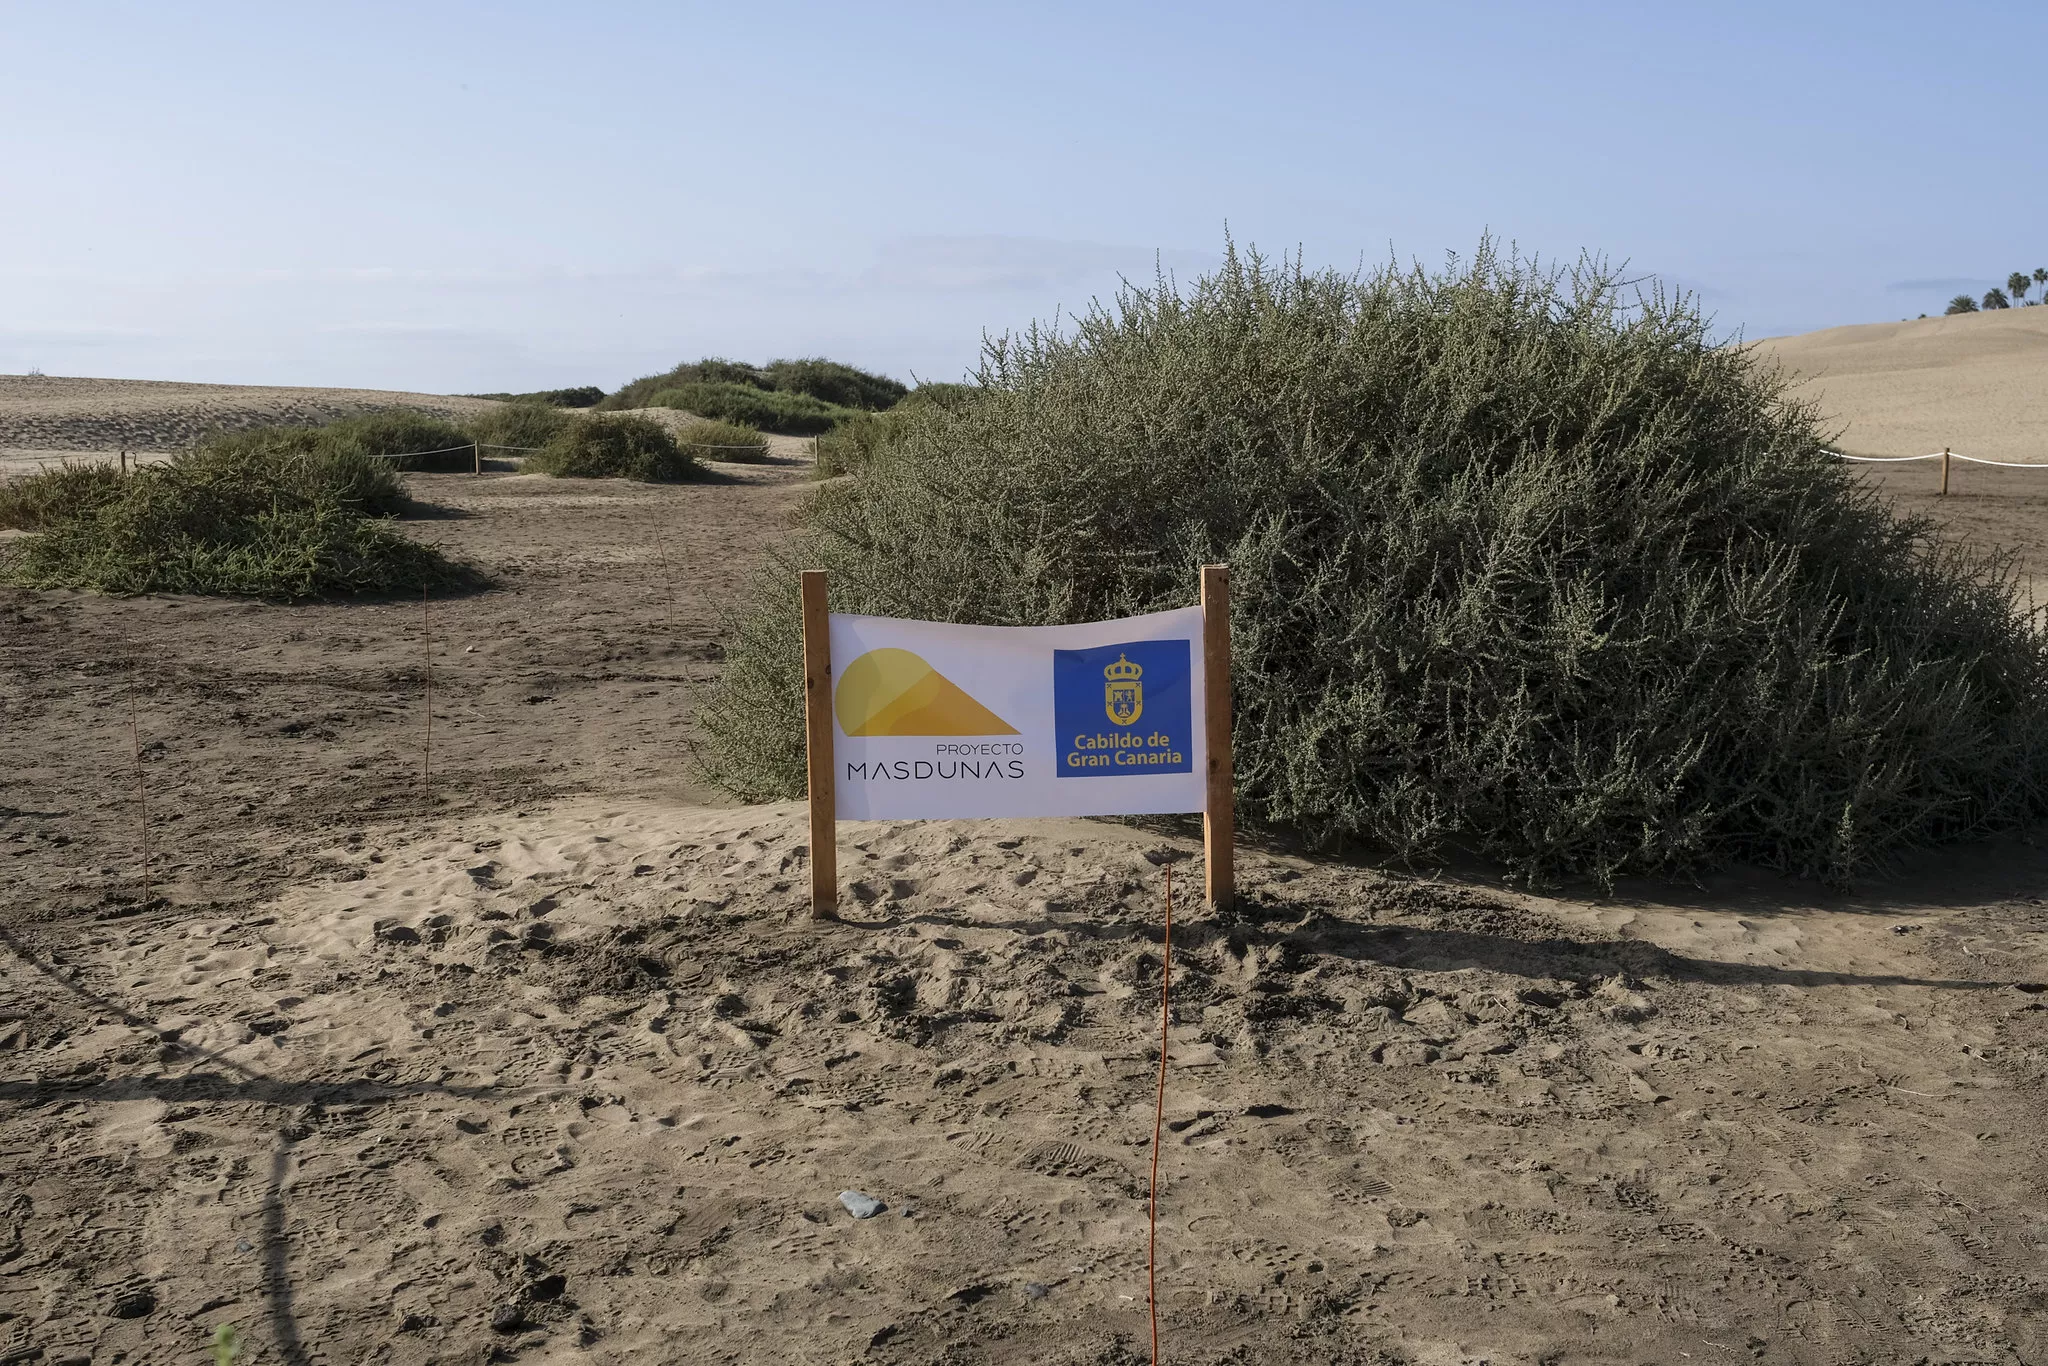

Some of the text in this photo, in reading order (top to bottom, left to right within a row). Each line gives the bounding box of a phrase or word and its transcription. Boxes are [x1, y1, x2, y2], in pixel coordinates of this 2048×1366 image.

[1074, 731, 1170, 749] Cabildo de
[936, 743, 1024, 756] PROYECTO
[1067, 748, 1182, 767] Gran Canaria
[847, 760, 1025, 780] MASDUNAS
